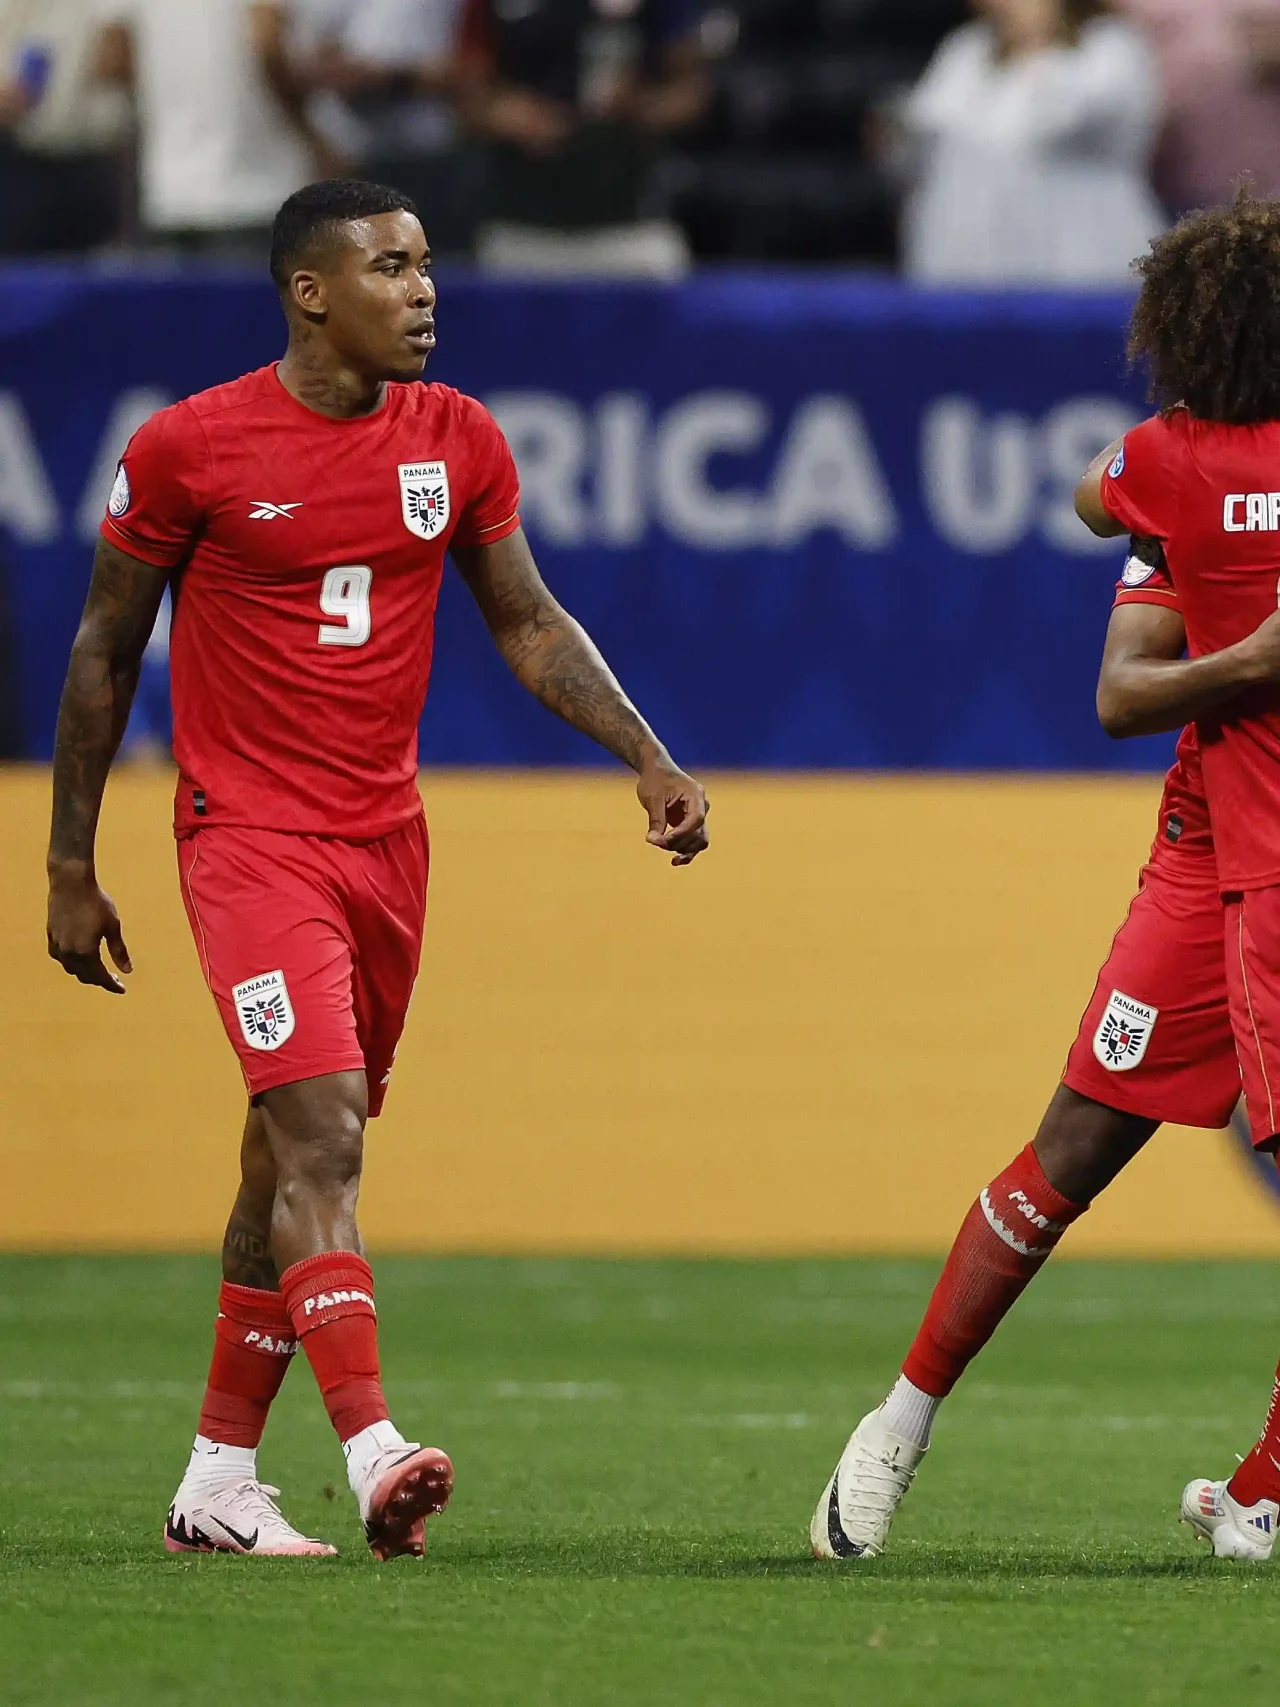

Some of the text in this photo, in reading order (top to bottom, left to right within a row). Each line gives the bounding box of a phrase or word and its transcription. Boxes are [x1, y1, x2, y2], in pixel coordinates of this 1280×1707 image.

[403, 464, 441, 478] PANAMÁ
[318, 564, 373, 647] 9
[1112, 995, 1151, 1020] PANAMÁ
